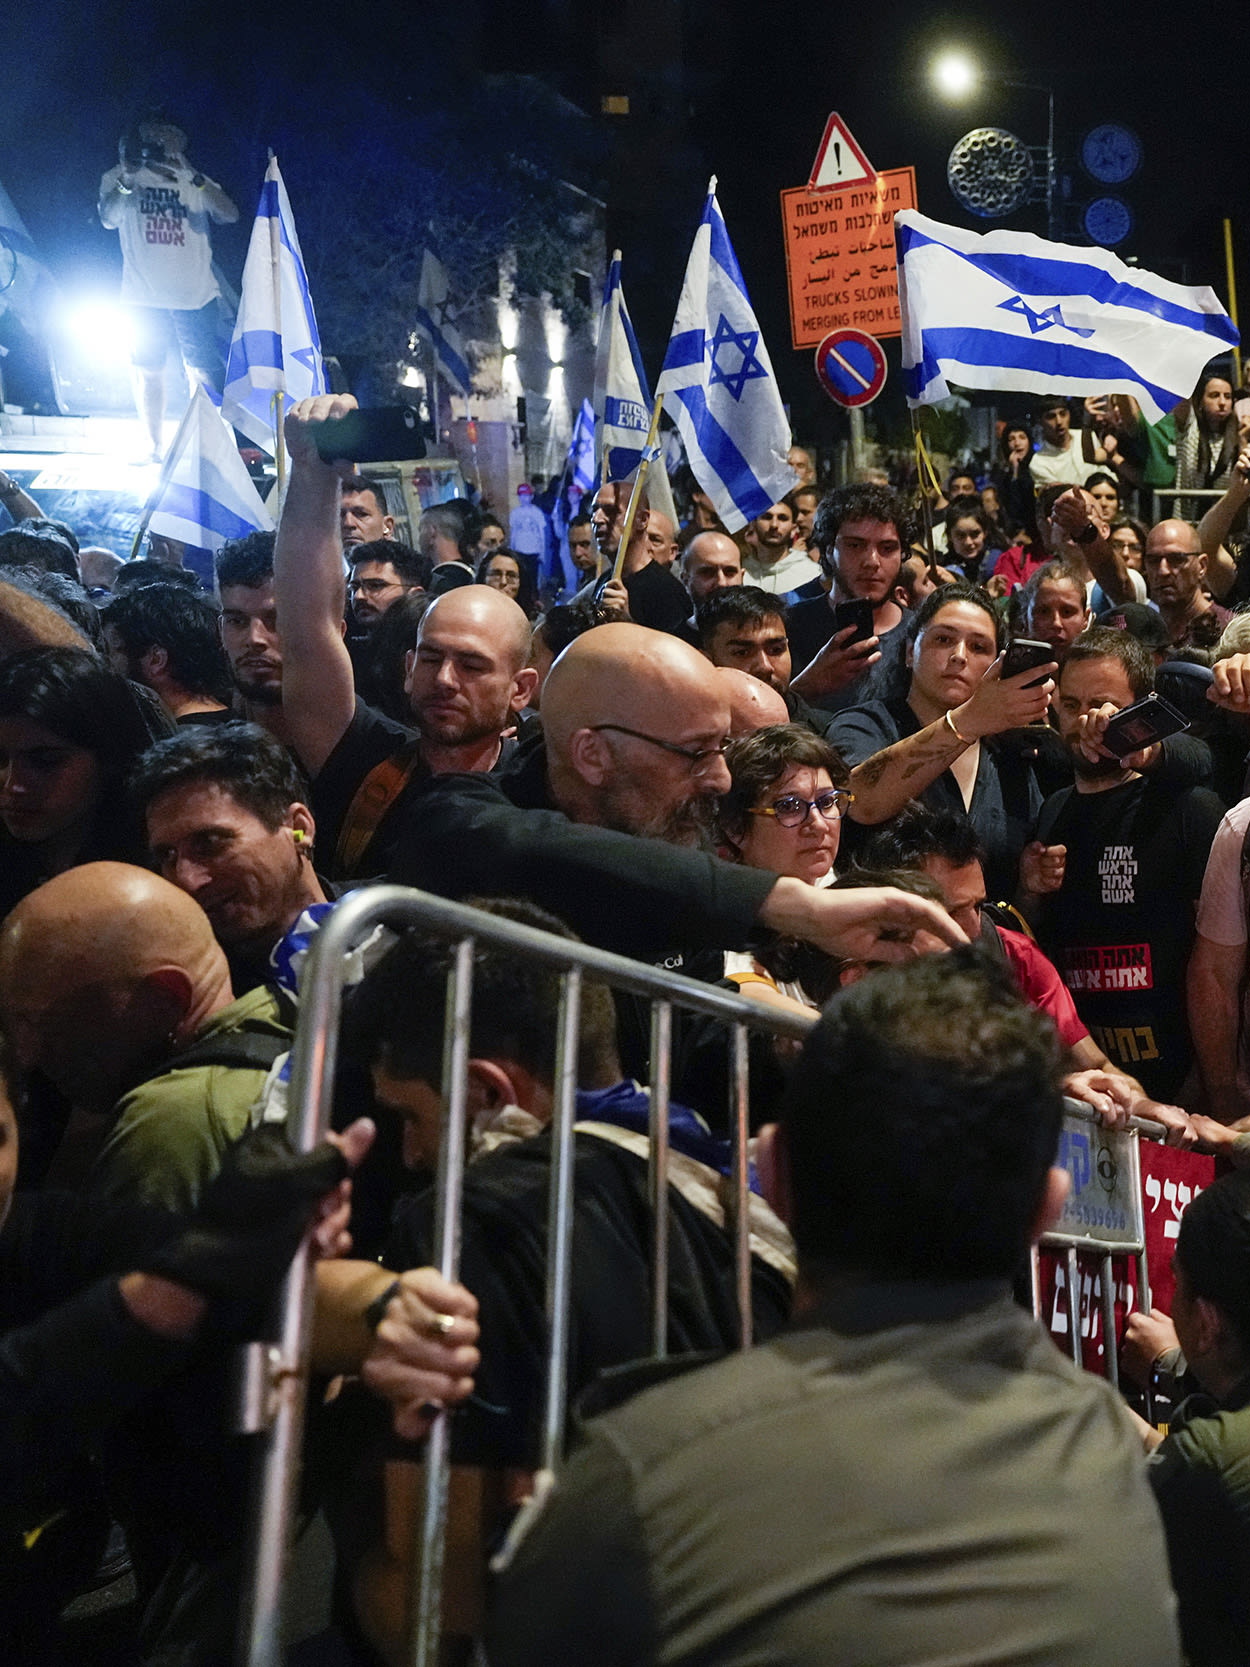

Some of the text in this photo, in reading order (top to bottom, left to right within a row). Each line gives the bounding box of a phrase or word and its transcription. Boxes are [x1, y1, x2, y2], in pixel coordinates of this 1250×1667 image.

[146, 187, 180, 201] אתה
[796, 186, 900, 217] משאיות מאיטות
[146, 215, 183, 231] אתה
[792, 220, 838, 239] משמאל
[145, 230, 185, 247] אשם
[801, 265, 836, 290] اليسار
[842, 268, 861, 283] من
[804, 284, 899, 309] TRUCKS SLOWIN
[802, 304, 900, 332] MERGING FROM LE
[1103, 845, 1134, 861] אתה
[1097, 860, 1138, 875] הראש
[1102, 874, 1134, 890] אתה
[1101, 889, 1135, 904] אשם
[664, 954, 684, 969] Col
[1104, 966, 1148, 988] אתה
